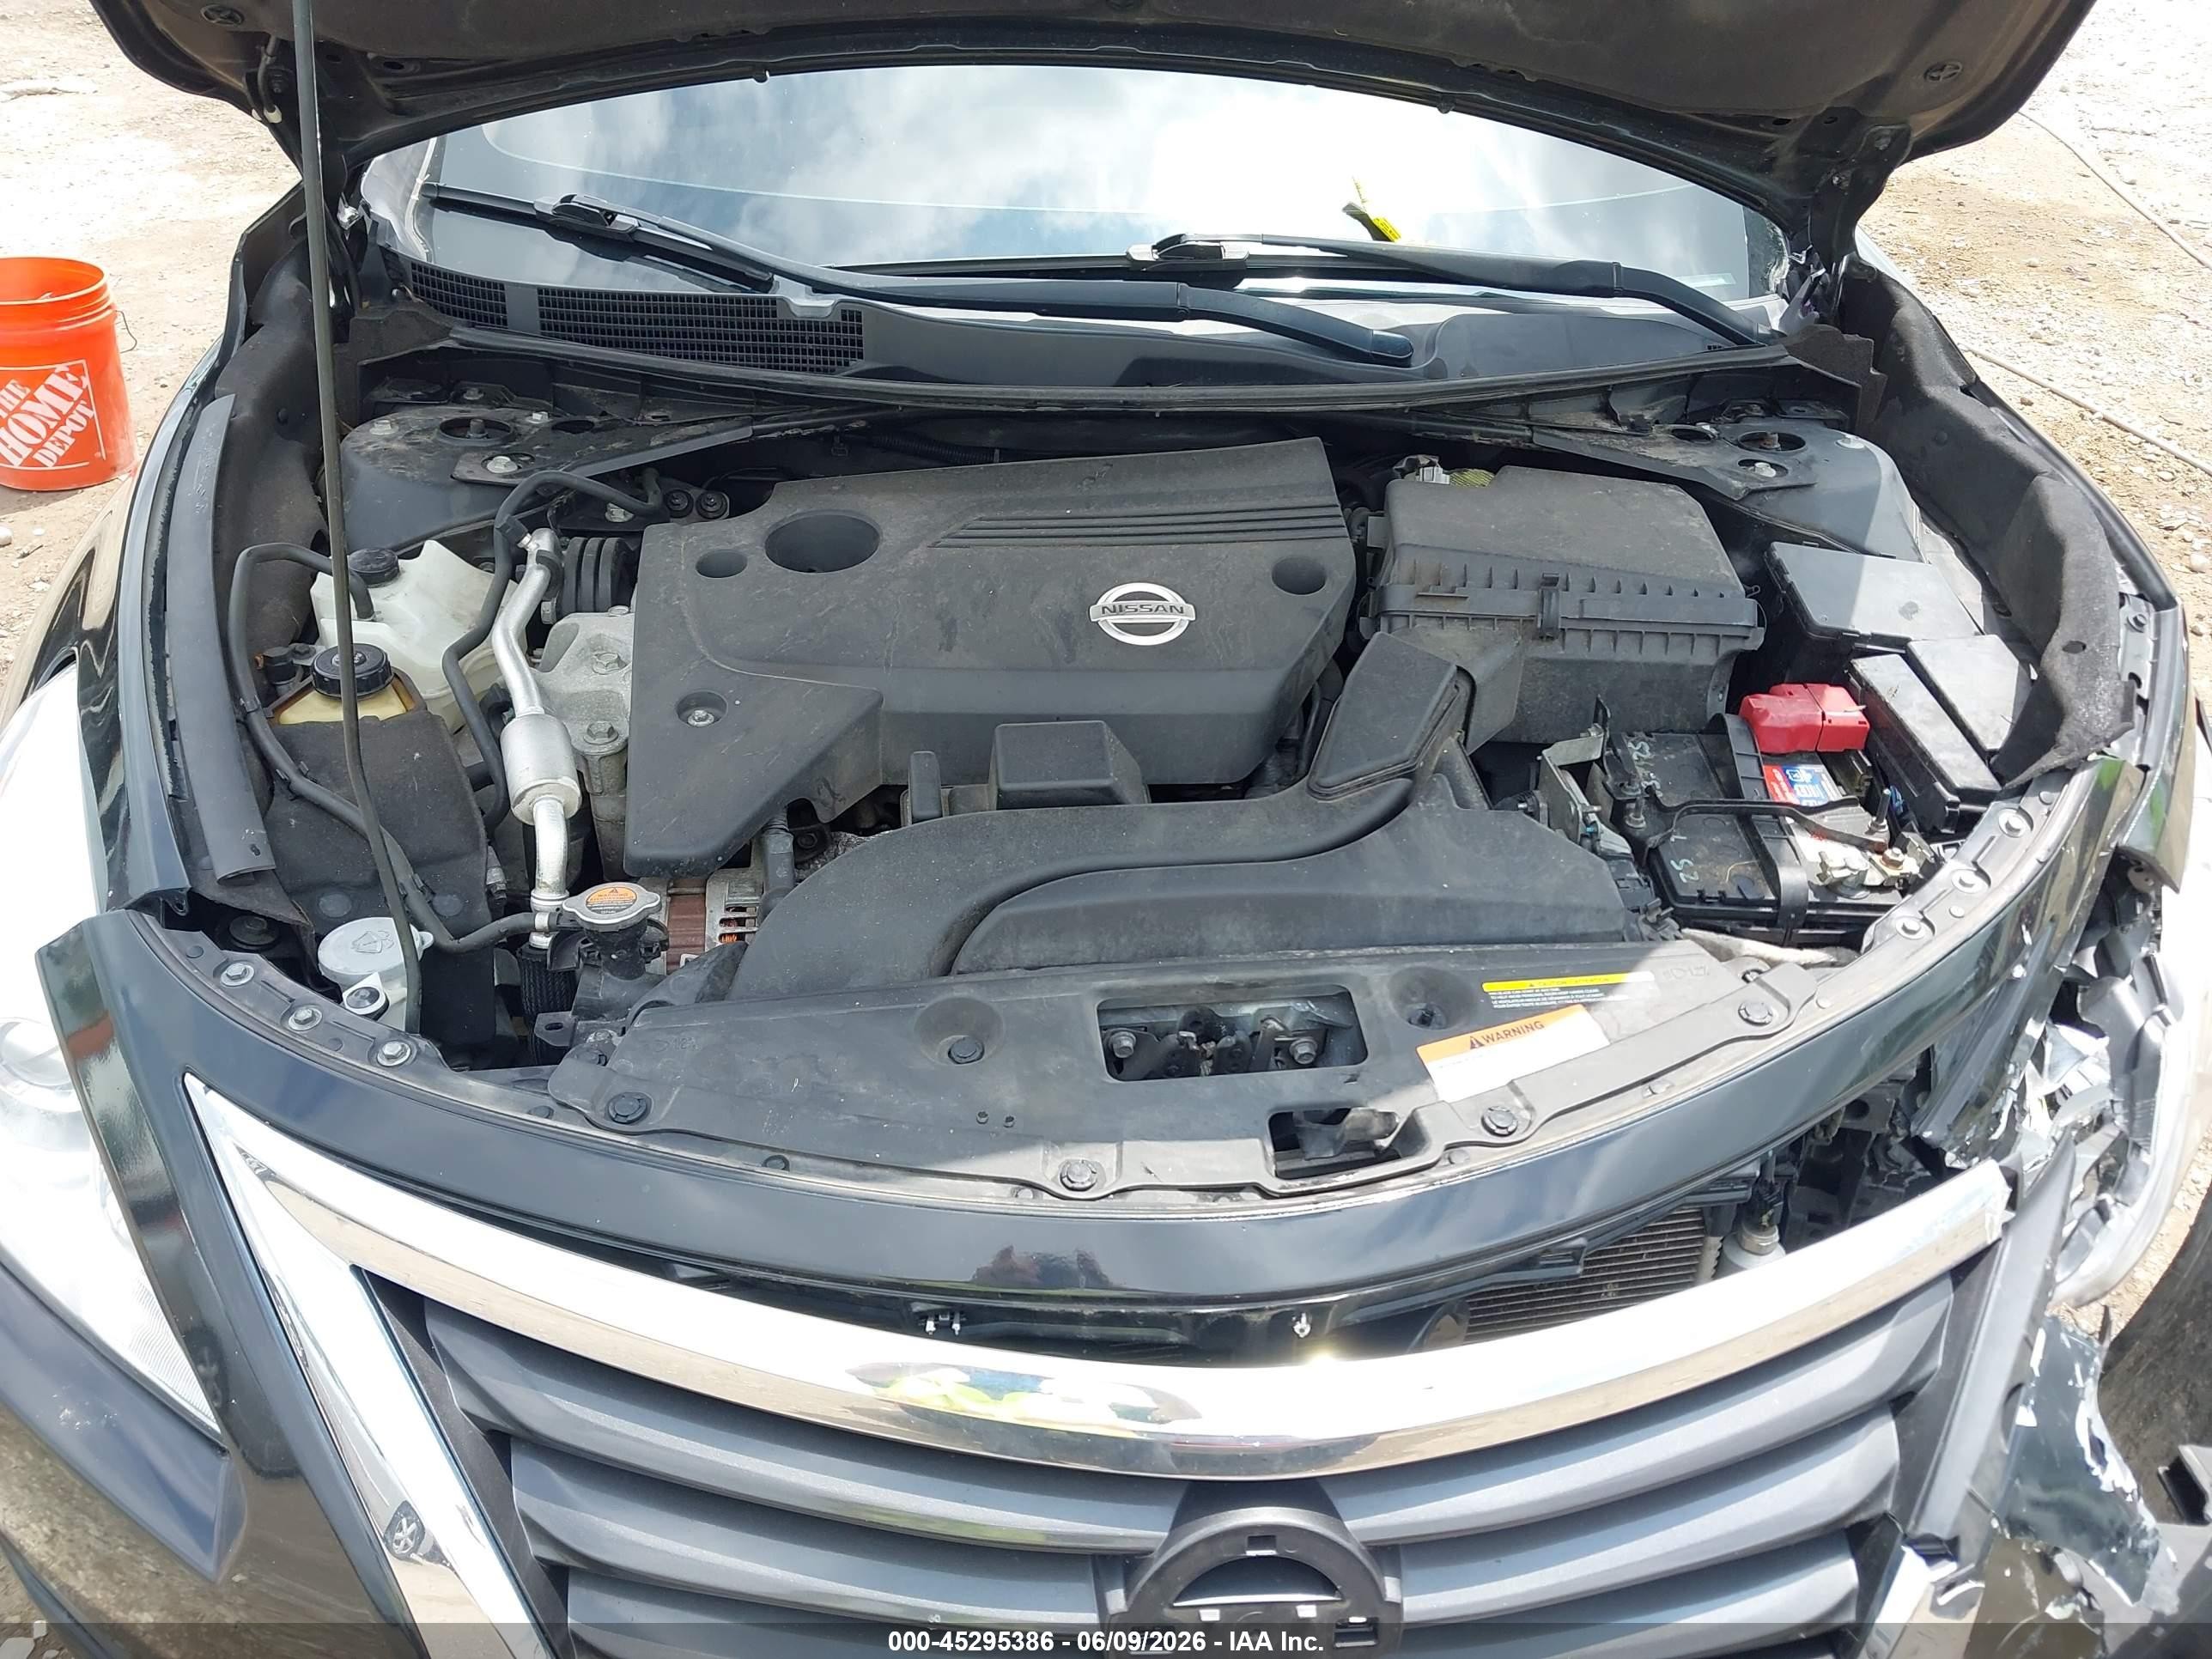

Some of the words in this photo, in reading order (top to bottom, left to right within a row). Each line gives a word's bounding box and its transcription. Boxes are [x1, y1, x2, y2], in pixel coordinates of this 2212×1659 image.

[0, 365, 88, 466] HOME
[33, 400, 94, 467] DEPOT
[1101, 604, 1184, 615] NISSAN
[1481, 1021, 1545, 1043] WARNING
